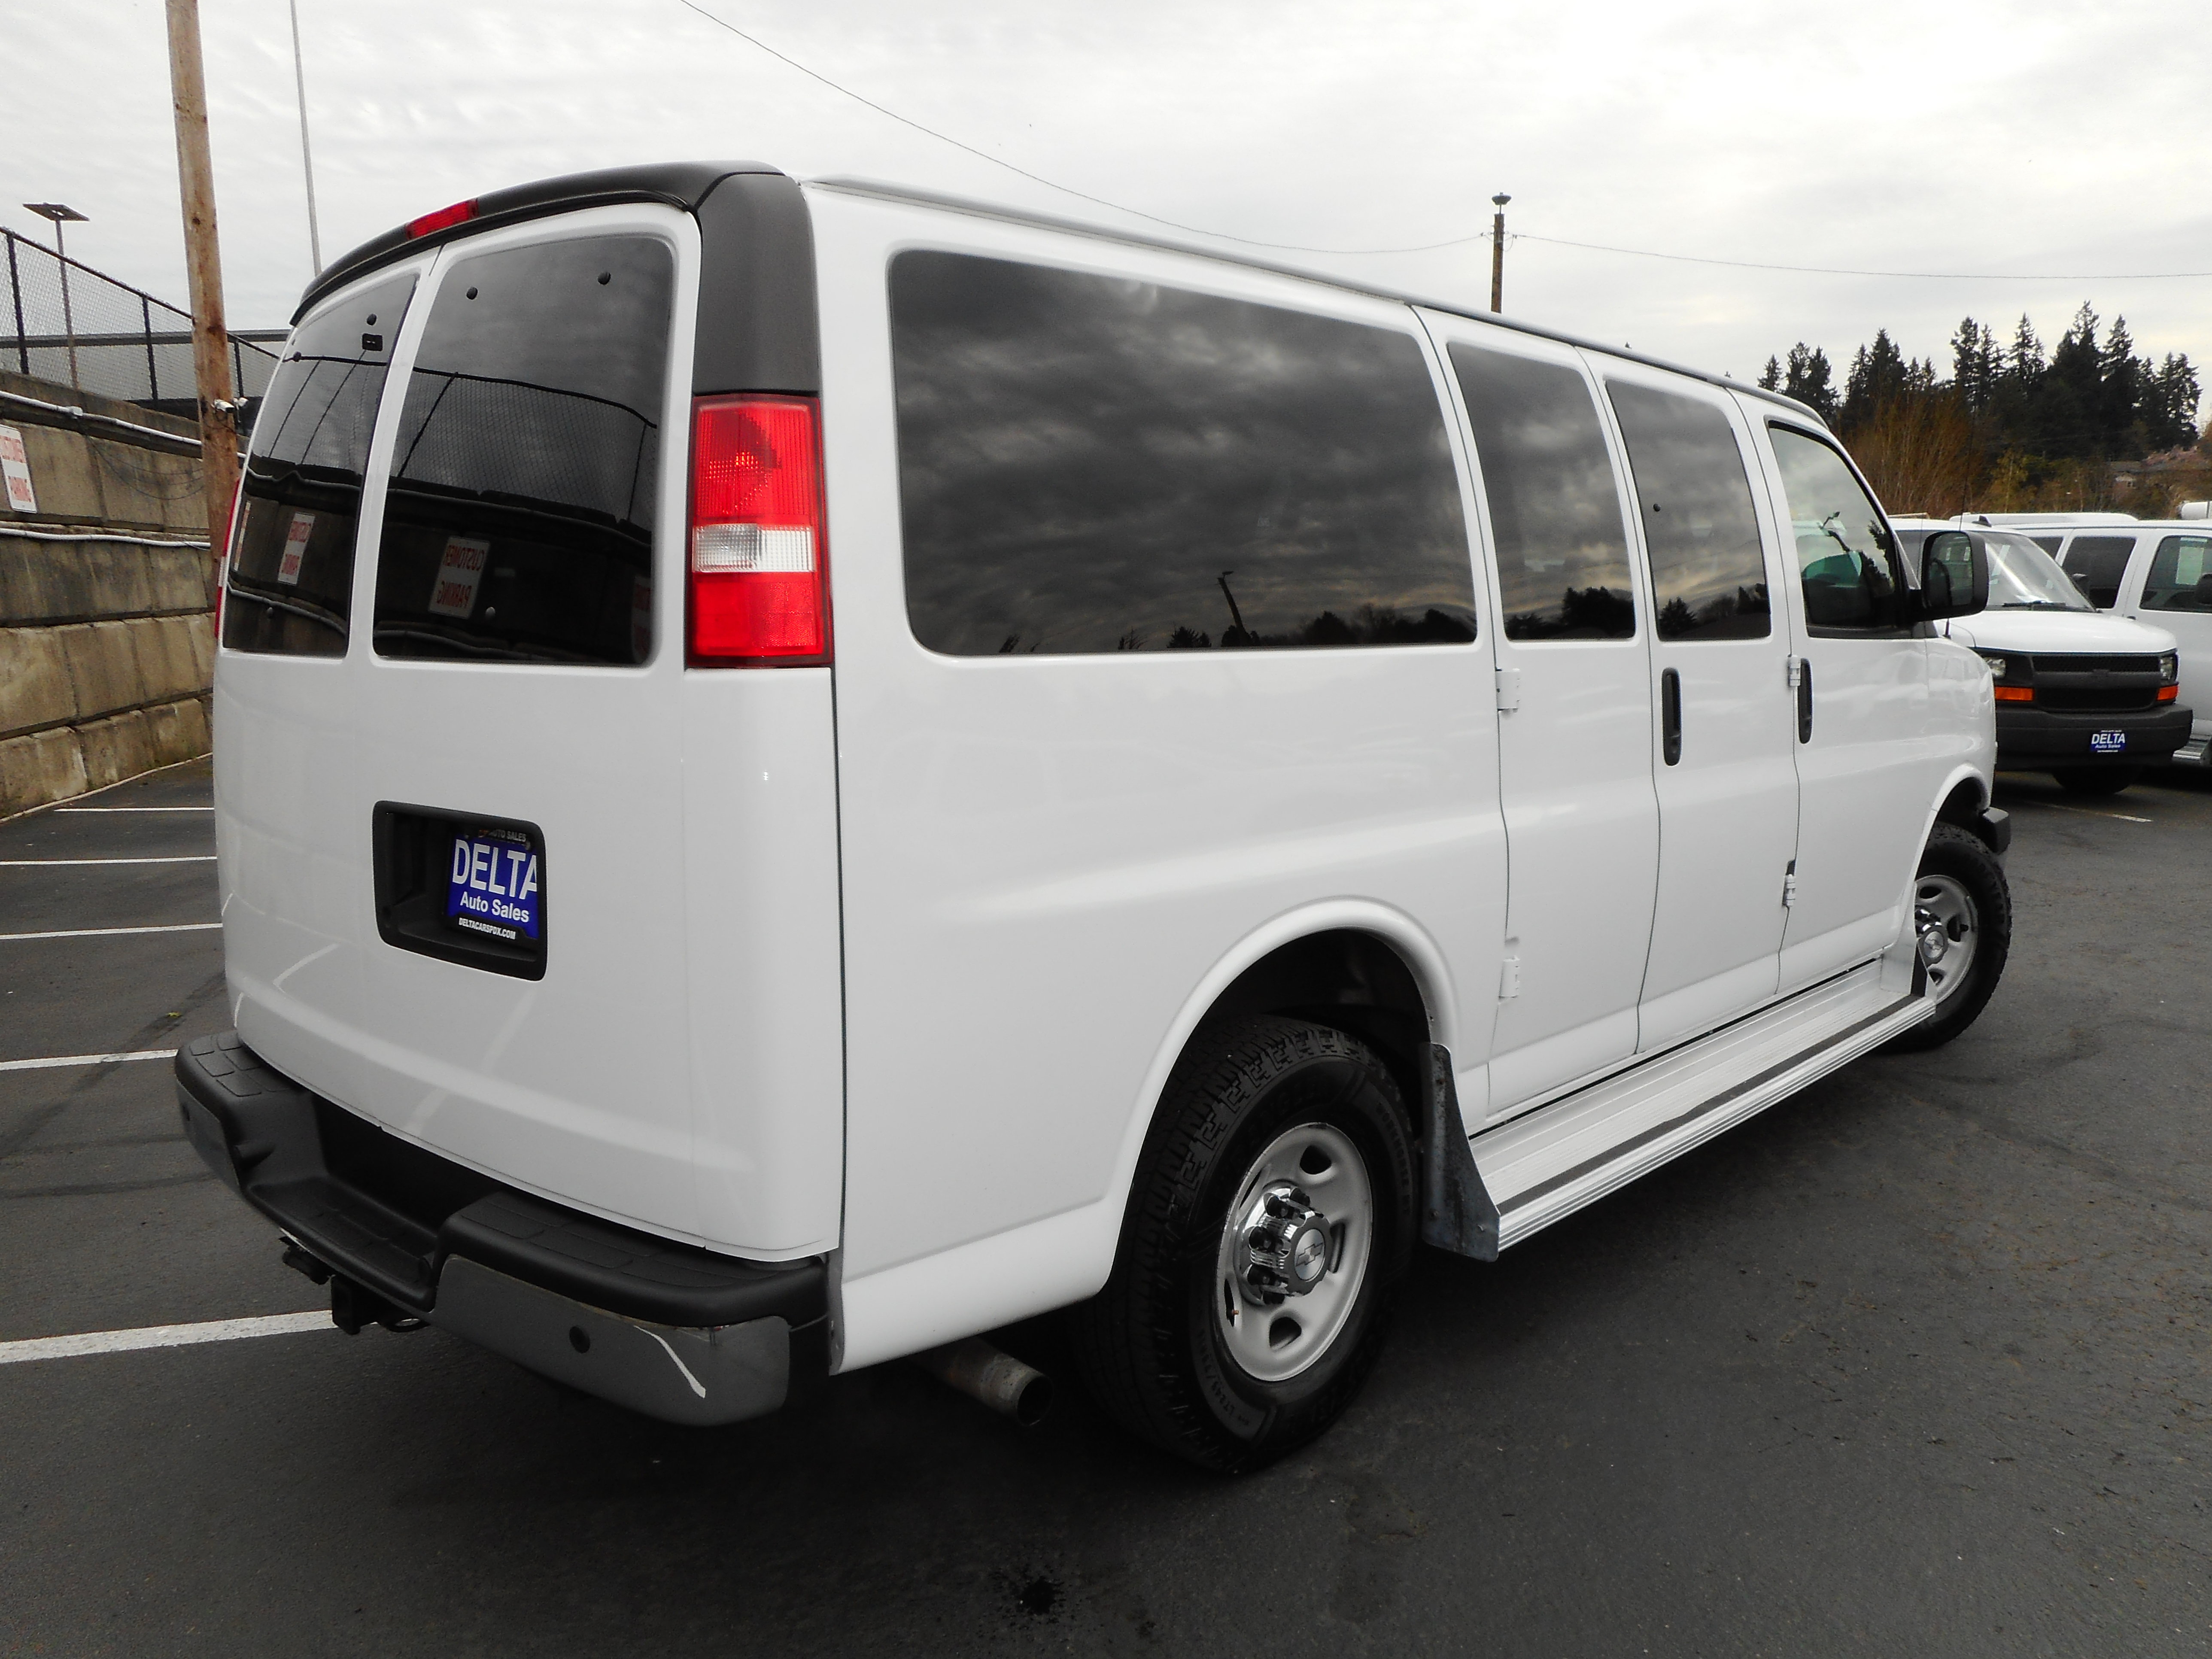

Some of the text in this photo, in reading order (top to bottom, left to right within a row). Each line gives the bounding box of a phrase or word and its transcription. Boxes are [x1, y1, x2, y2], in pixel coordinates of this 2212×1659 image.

[2091, 733, 2125, 744] DELTA
[507, 830, 527, 842] SALES
[452, 839, 538, 900] DELTA
[460, 891, 529, 923] Auto Sales
[459, 917, 516, 940] DELTACARSPDX.COM
